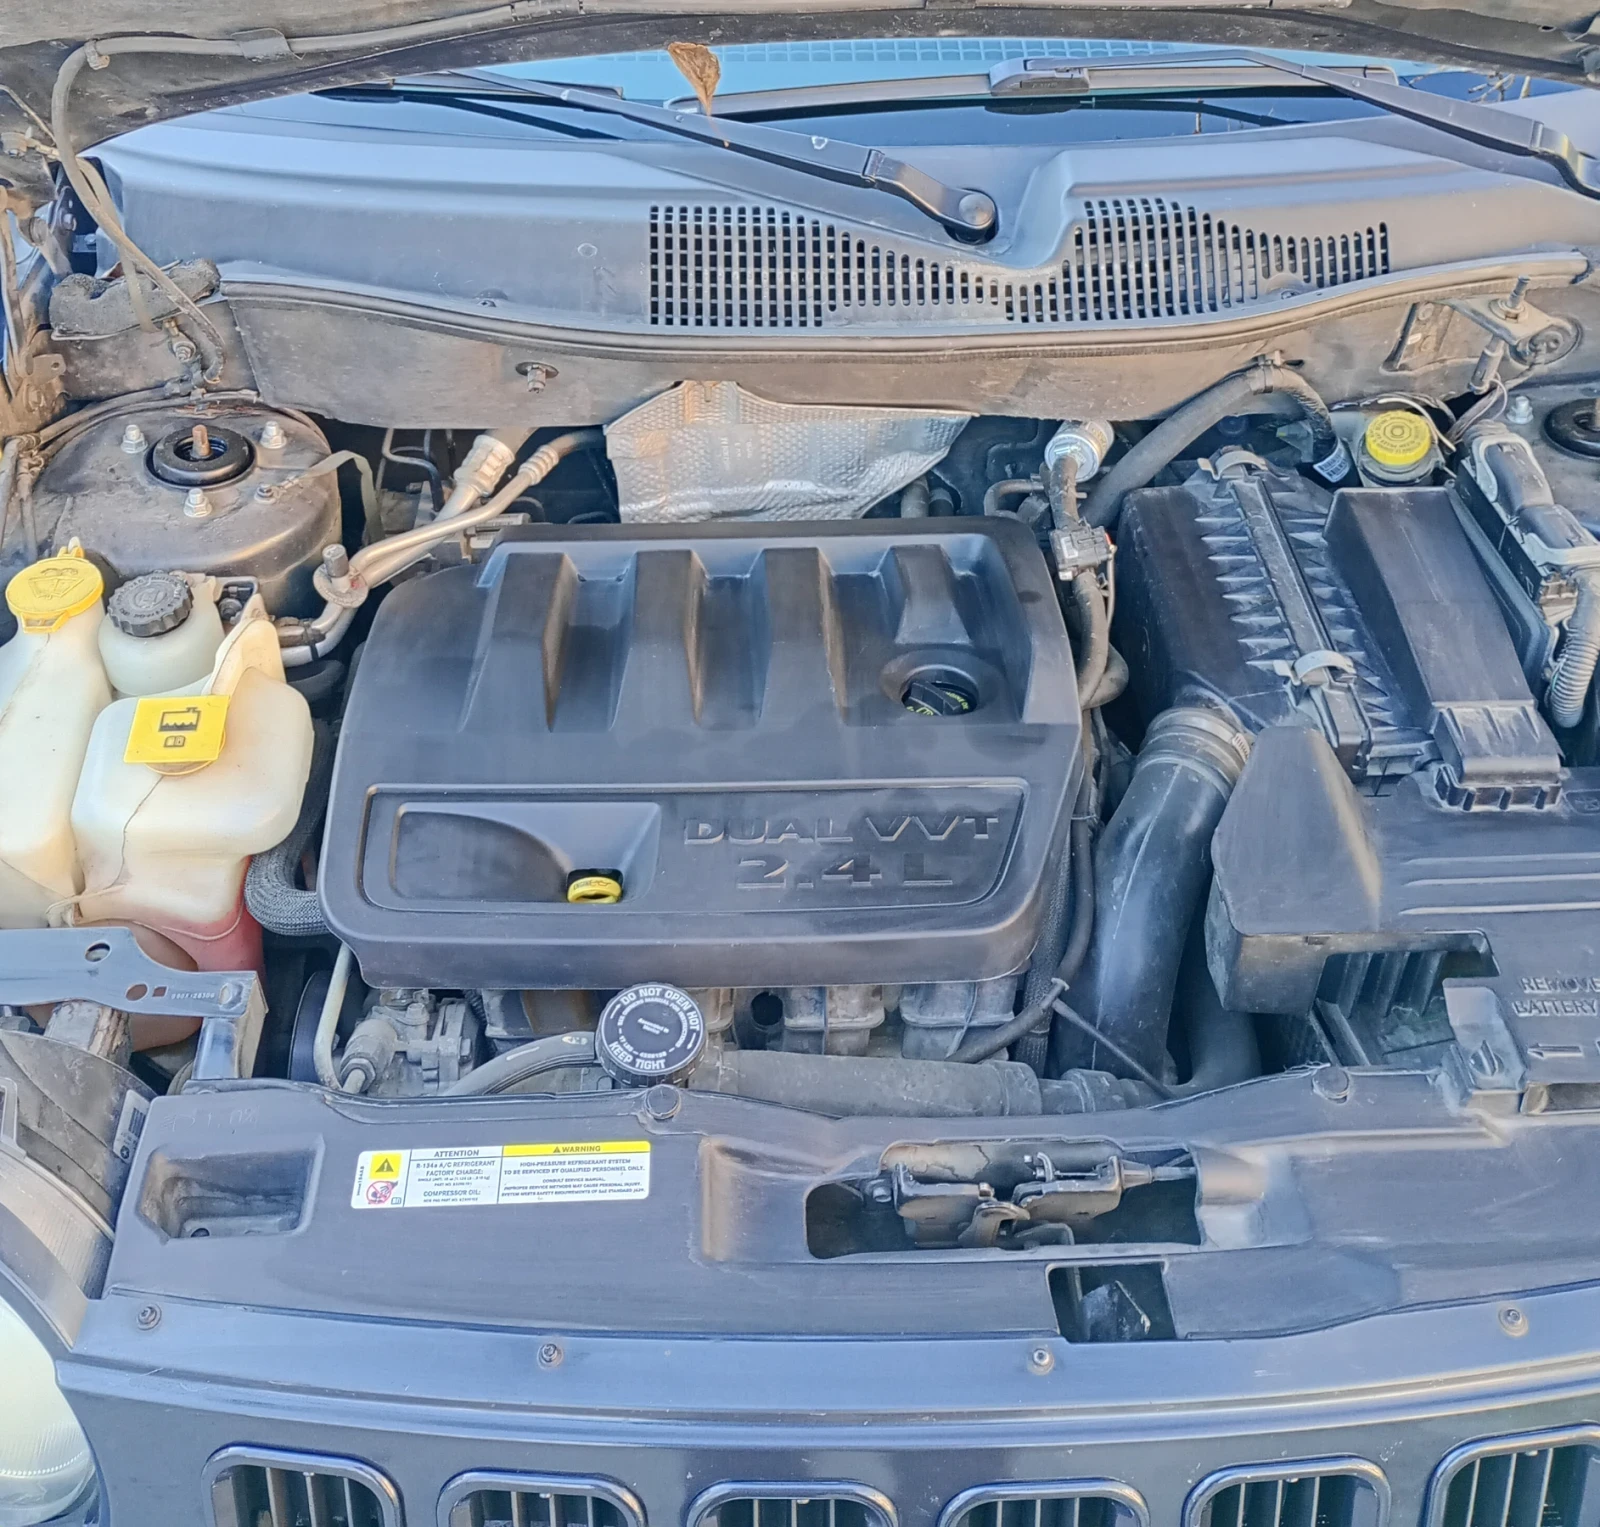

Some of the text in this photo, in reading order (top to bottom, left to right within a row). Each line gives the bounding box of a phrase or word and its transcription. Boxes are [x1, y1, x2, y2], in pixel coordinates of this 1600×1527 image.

[684, 815, 999, 845] DUAL VVT
[620, 987, 700, 1031] DO NOT OPEN HOT
[669, 1002, 681, 1013] FOR
[1512, 999, 1598, 1017] BATTERY
[608, 1041, 634, 1063] KEEP
[634, 1059, 667, 1069] TIGHT
[434, 1149, 480, 1158] ATTENTION
[562, 1145, 600, 1153] WARNING
[426, 1169, 454, 1177] FACTORY
